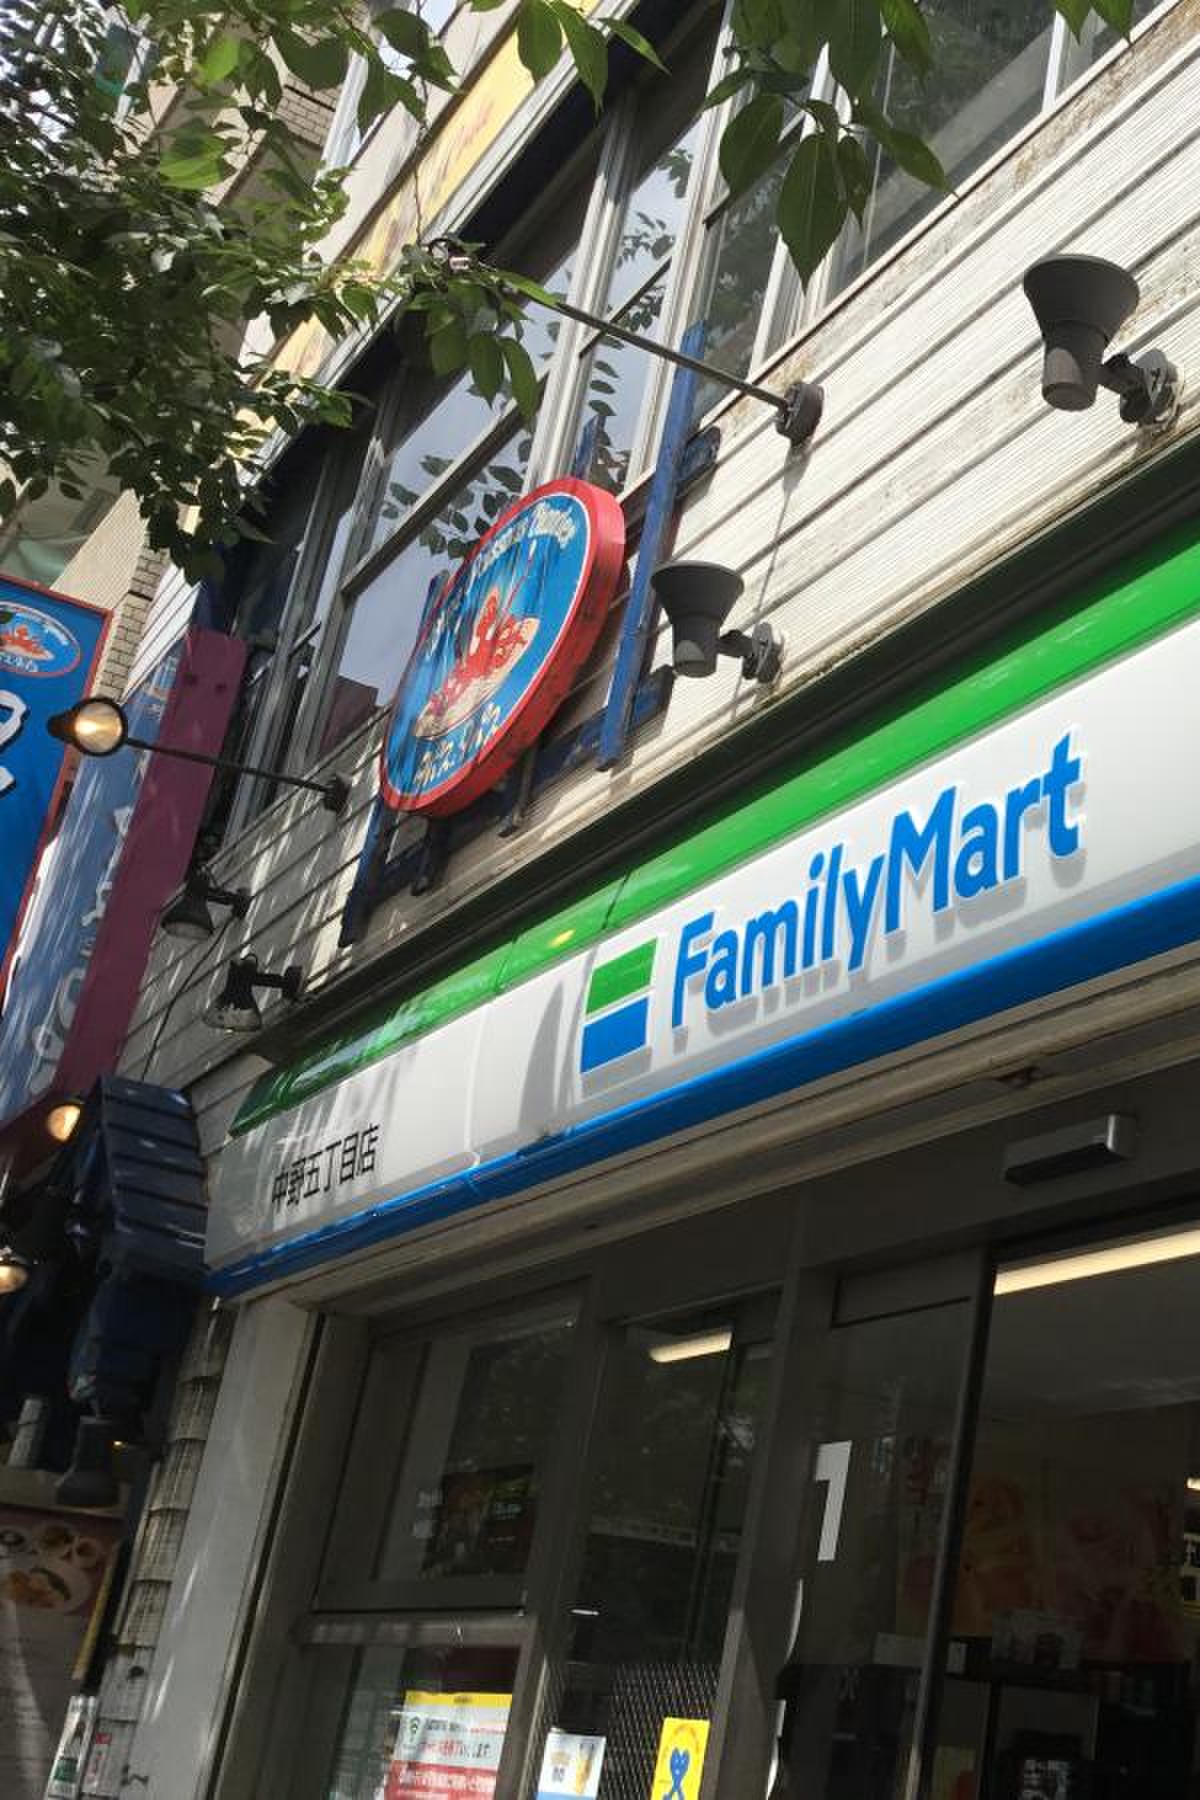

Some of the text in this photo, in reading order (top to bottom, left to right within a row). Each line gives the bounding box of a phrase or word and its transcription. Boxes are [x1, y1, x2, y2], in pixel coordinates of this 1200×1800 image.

[671, 732, 1082, 1029] FamilyMart
[271, 1123, 380, 1214] 中野五丁目店
[814, 1439, 853, 1563] 1
